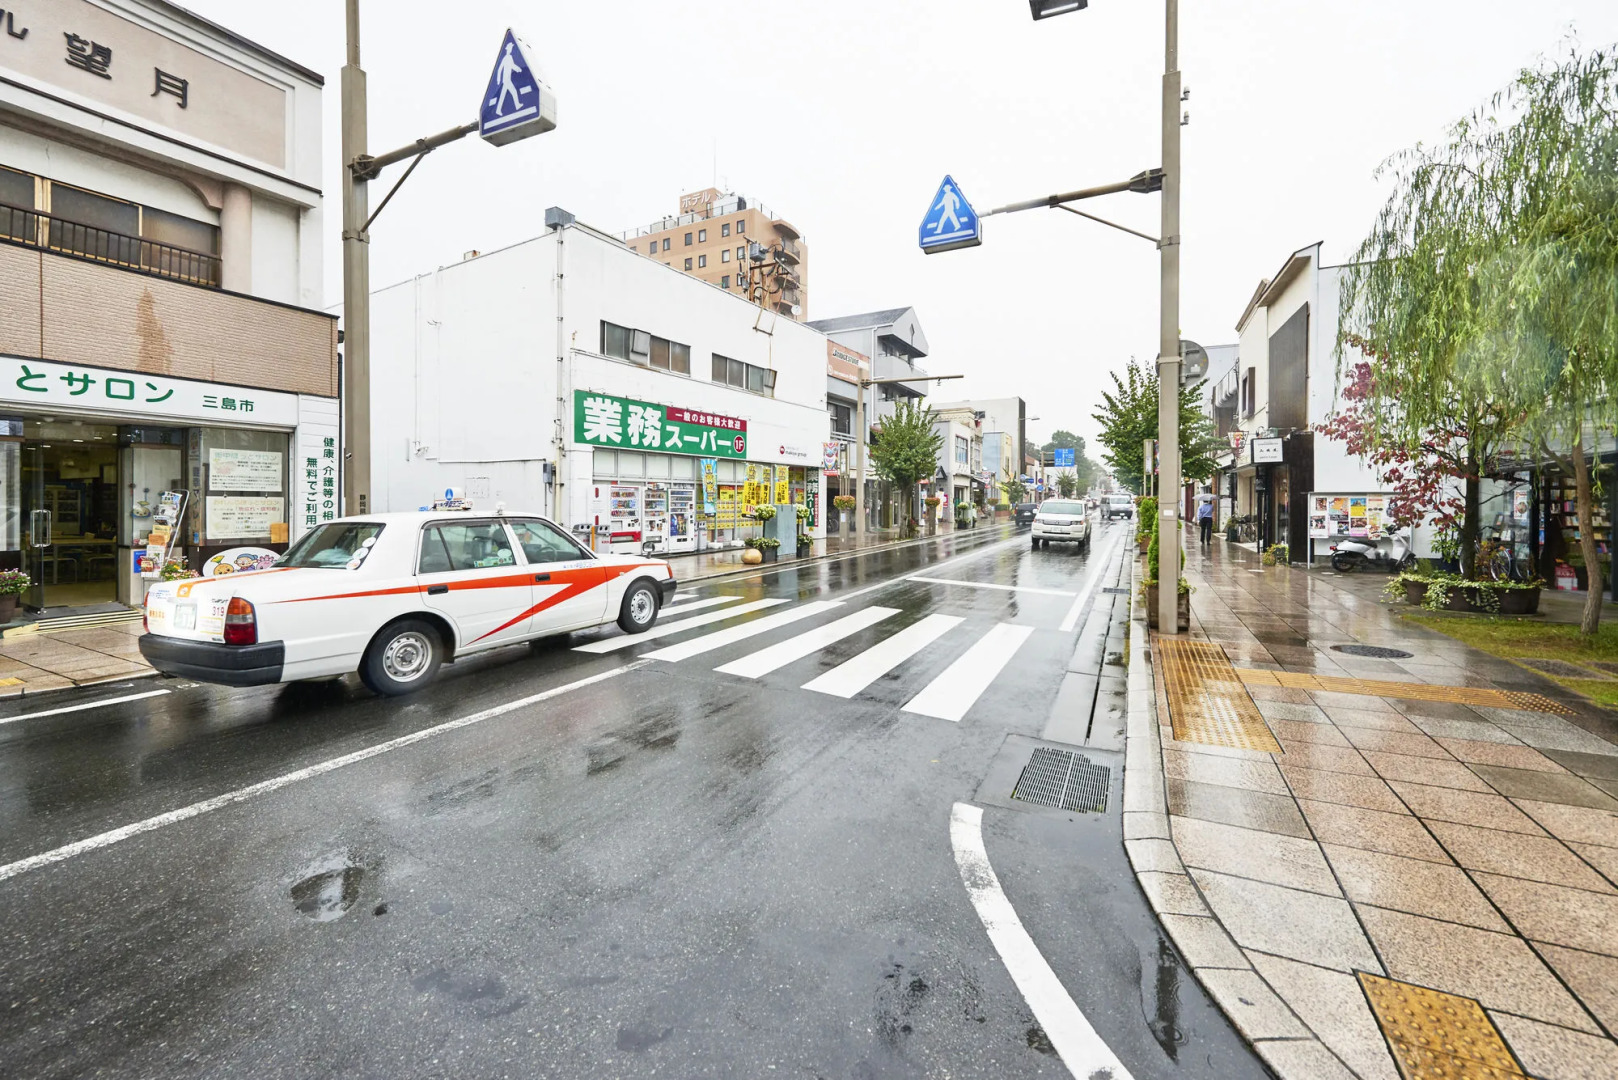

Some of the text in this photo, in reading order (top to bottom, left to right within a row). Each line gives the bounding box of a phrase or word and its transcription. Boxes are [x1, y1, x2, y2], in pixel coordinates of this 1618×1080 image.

[682, 190, 711, 208] ホテル
[16, 364, 174, 404] とサロン
[202, 395, 255, 413] 三島市
[675, 411, 741, 431] 一般のお客様大歓迎
[735, 439, 745, 452] 1F
[212, 606, 225, 616] 319
